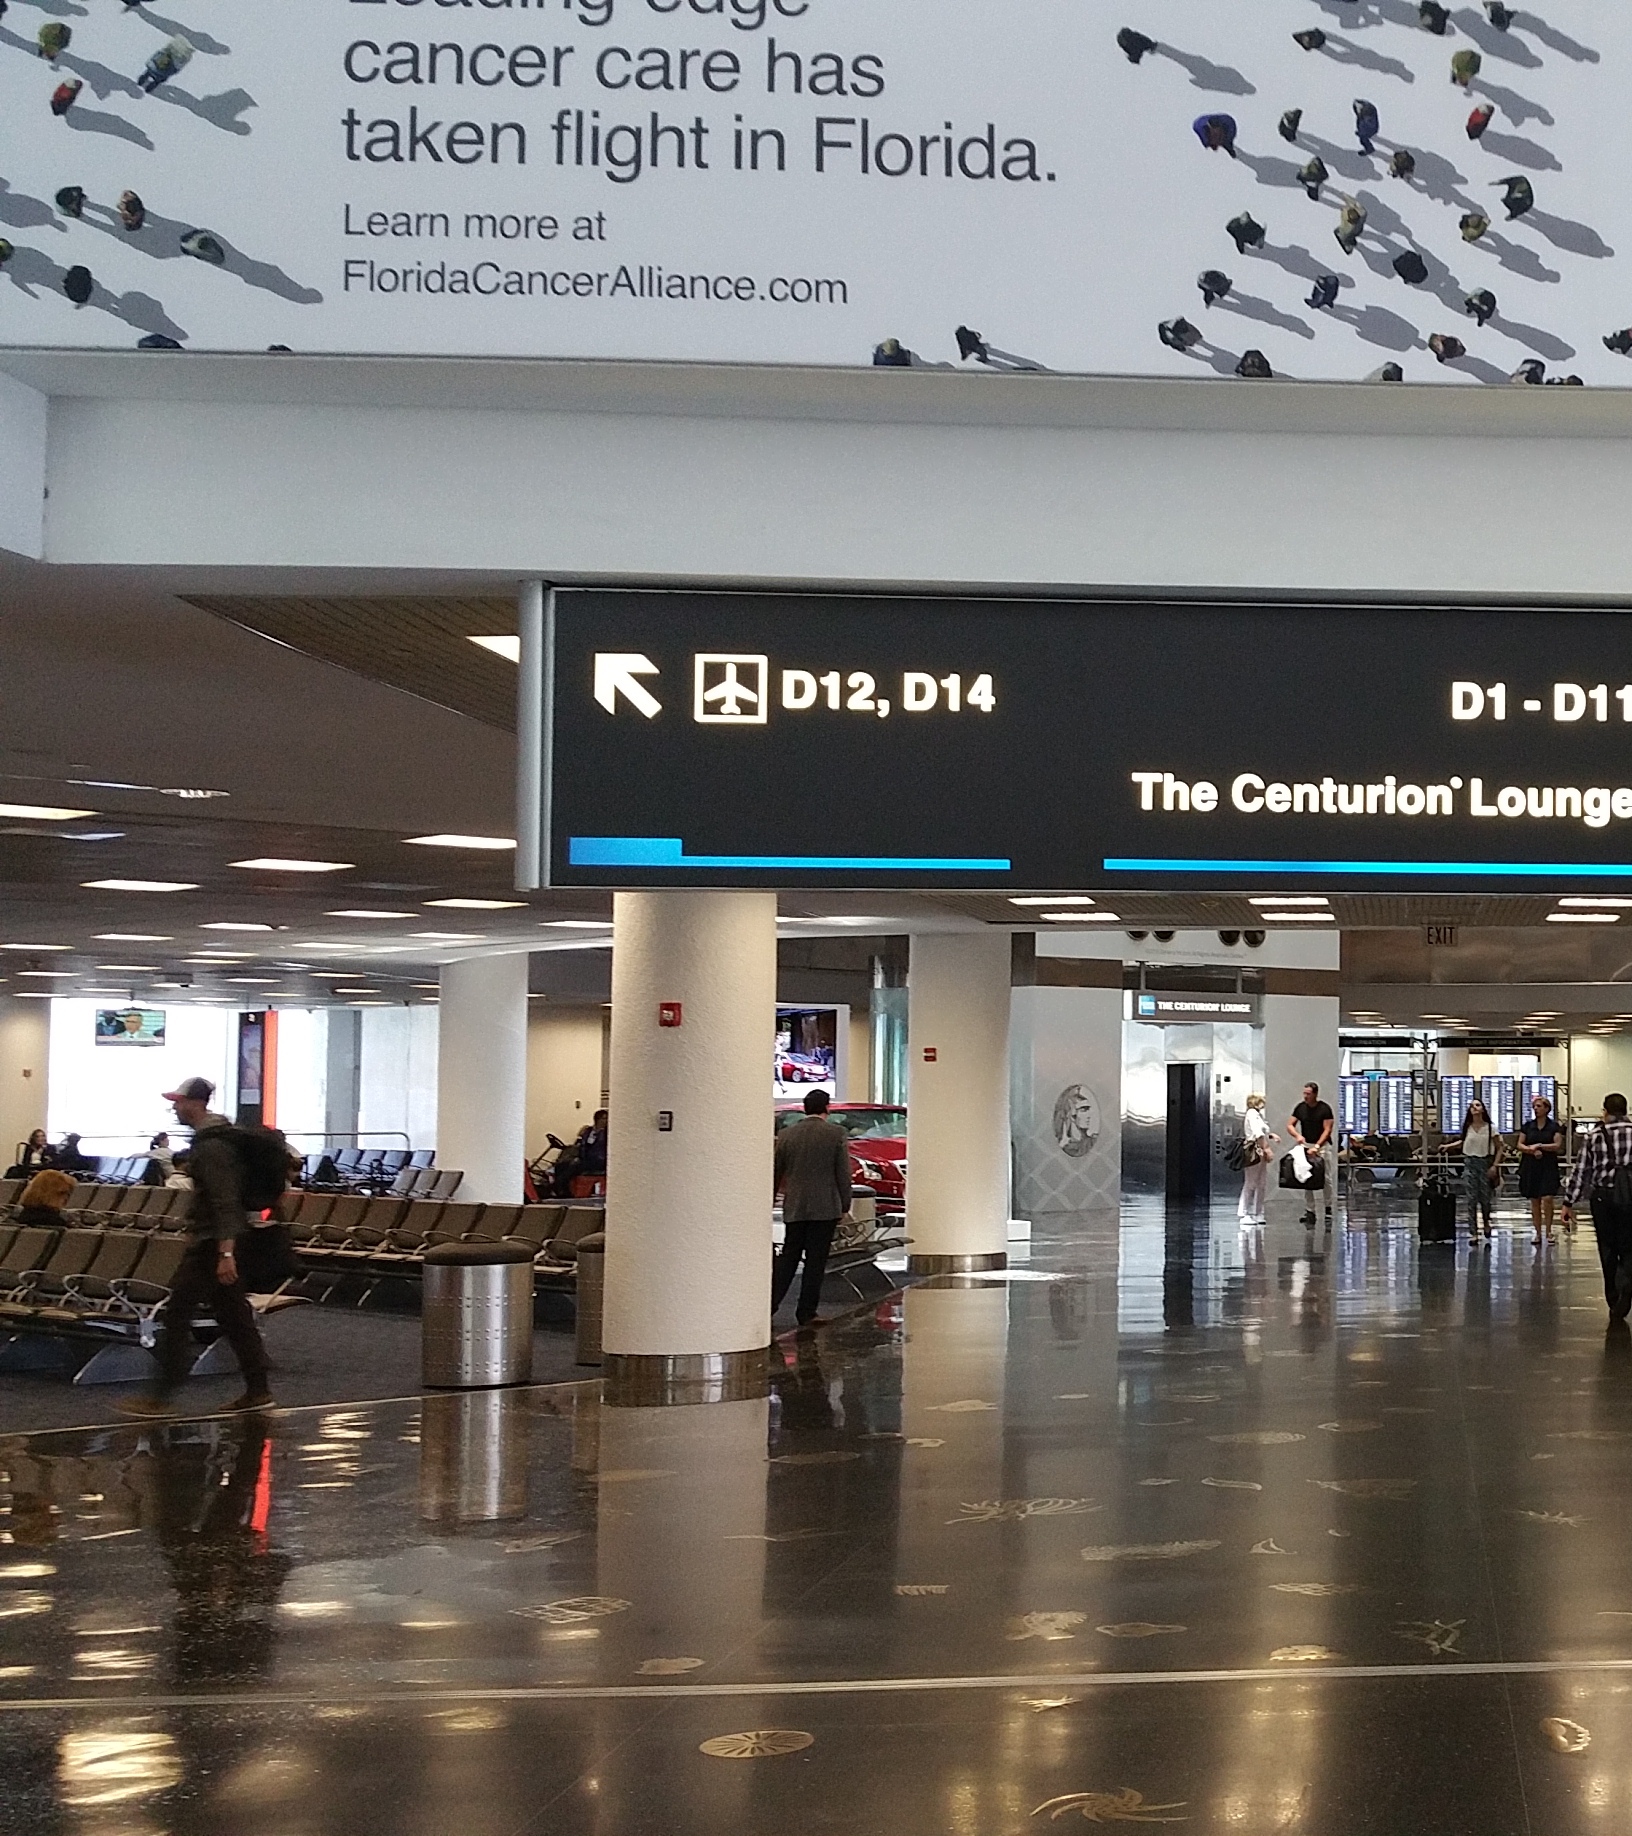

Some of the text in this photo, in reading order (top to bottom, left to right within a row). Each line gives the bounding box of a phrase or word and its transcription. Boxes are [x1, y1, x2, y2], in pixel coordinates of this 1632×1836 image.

[344, 38, 885, 98] cancer care has
[342, 106, 1056, 182] taken flight in Florida.
[344, 203, 607, 241] Learn more at
[344, 259, 848, 304] FloridaCancerAlliance.com
[781, 669, 997, 718] D12, D14
[1451, 681, 1506, 721] D1
[1131, 771, 1219, 812] The
[1427, 926, 1456, 945] EXIT
[1157, 1001, 1173, 1011] THE
[1221, 1003, 1251, 1013] LOUNGE
